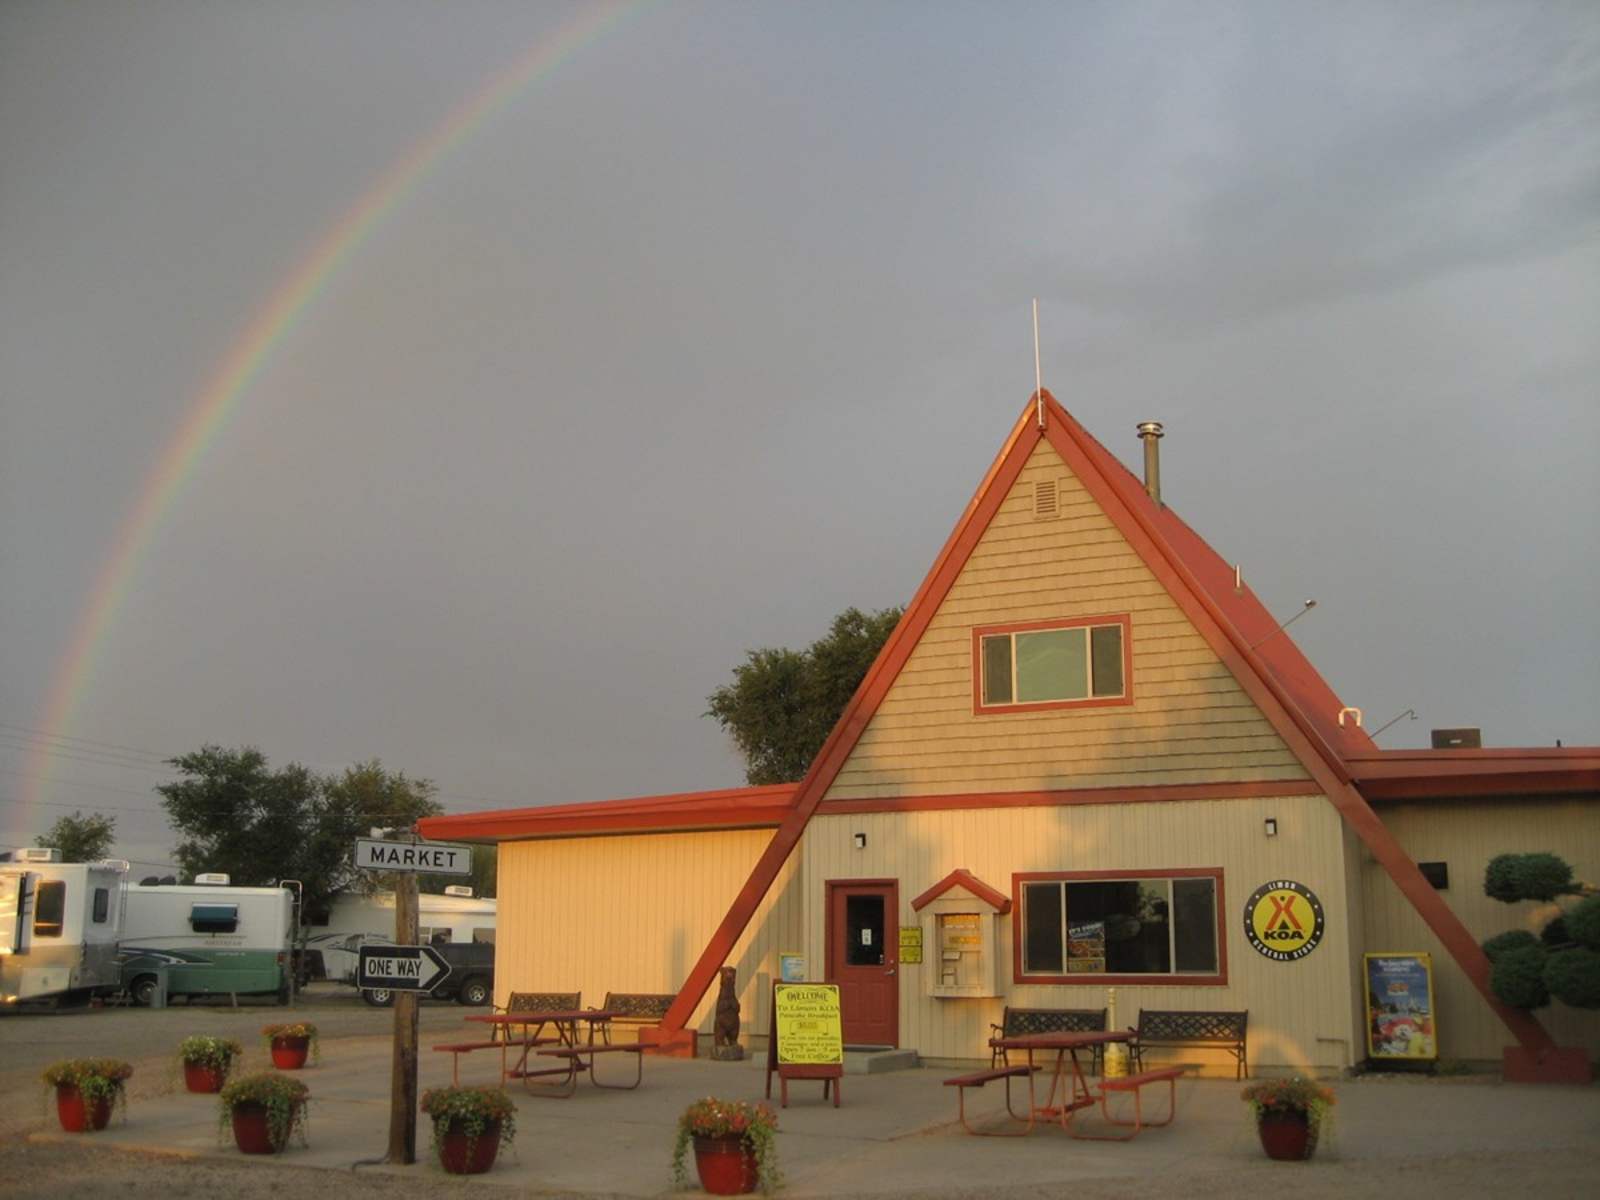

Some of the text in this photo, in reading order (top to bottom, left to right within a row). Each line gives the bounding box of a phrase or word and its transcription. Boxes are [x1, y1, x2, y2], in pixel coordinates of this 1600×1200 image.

[370, 847, 457, 868] MARKET
[1268, 882, 1296, 890] LIMON
[1263, 930, 1305, 940] KOA
[1252, 939, 1317, 960] GENERAL STORE
[368, 959, 423, 977] ONE WAY
[787, 991, 829, 1001] WELCOME
